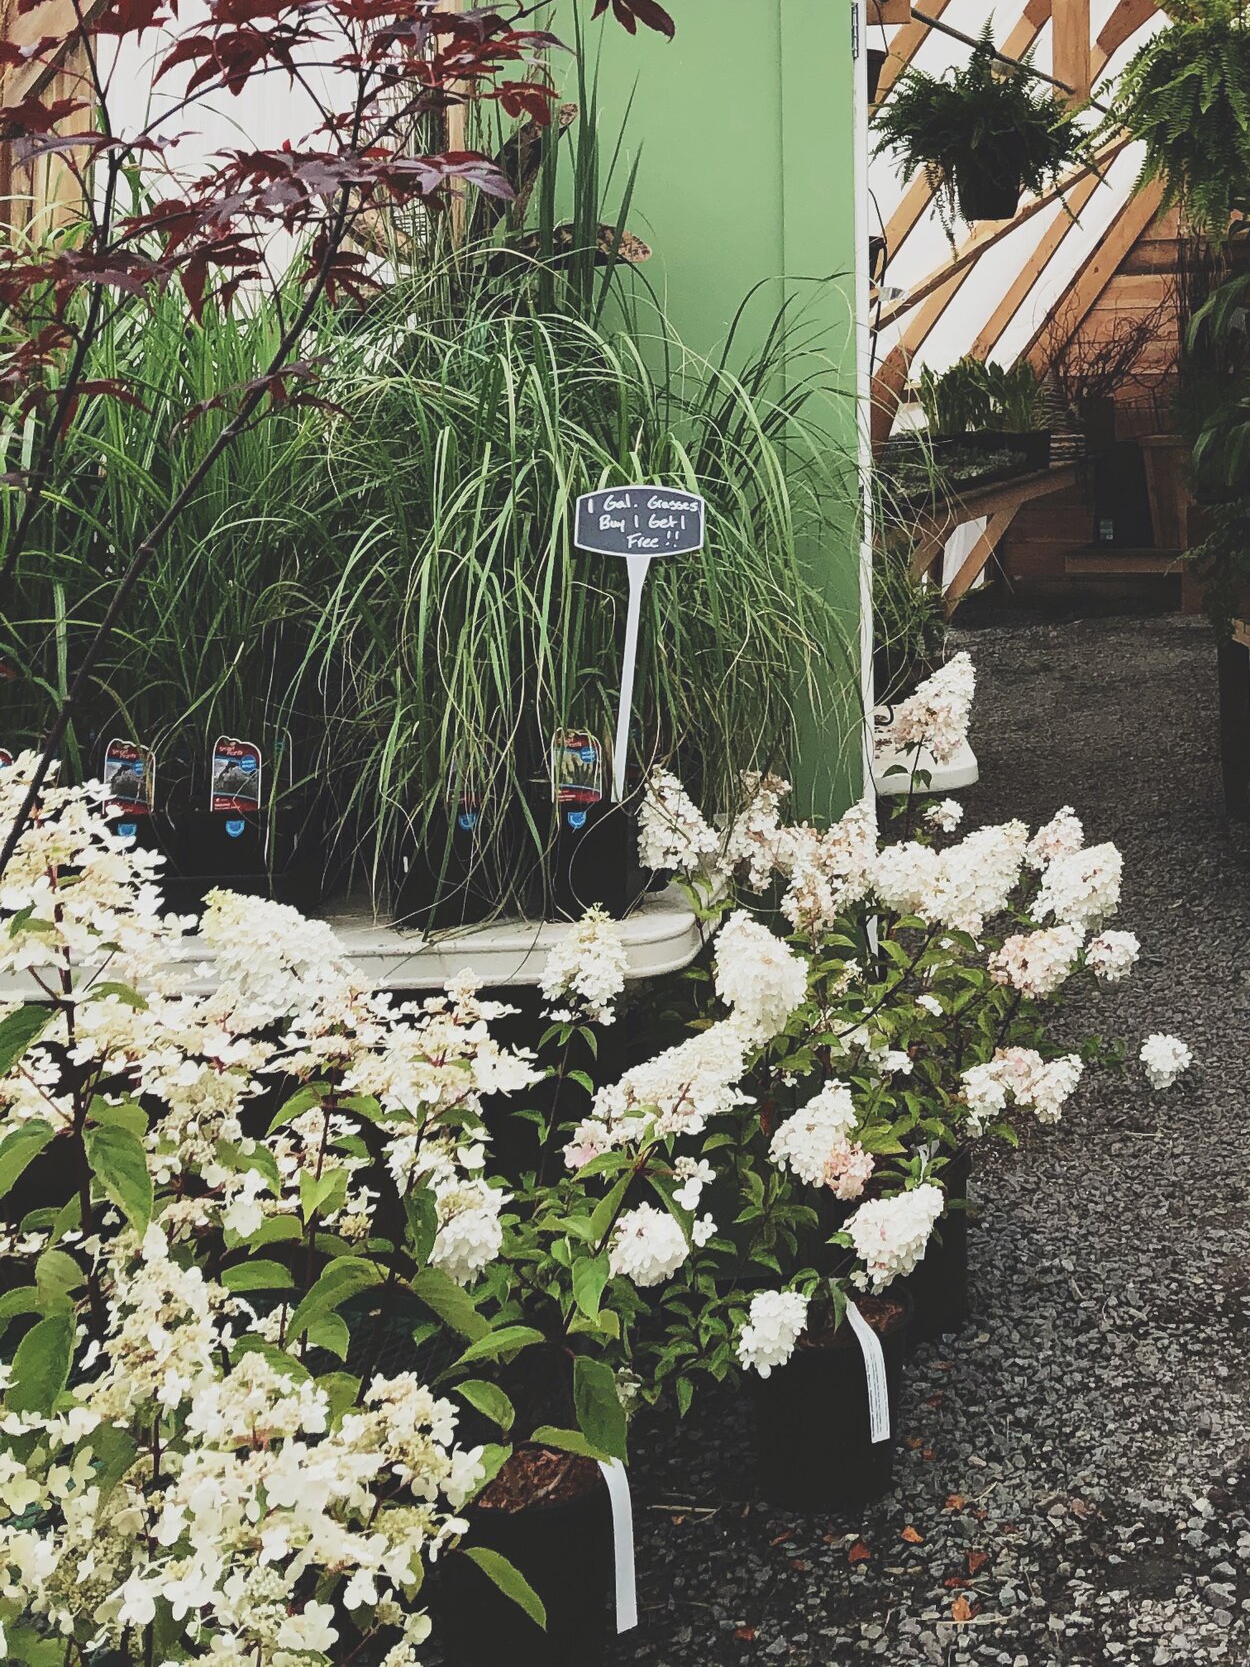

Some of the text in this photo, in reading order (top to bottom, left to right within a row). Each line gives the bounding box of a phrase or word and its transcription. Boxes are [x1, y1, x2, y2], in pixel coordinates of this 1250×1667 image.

[603, 493, 638, 511] Gal.
[647, 495, 699, 511] Grasses
[599, 514, 625, 532] Buy
[648, 514, 678, 528] Get
